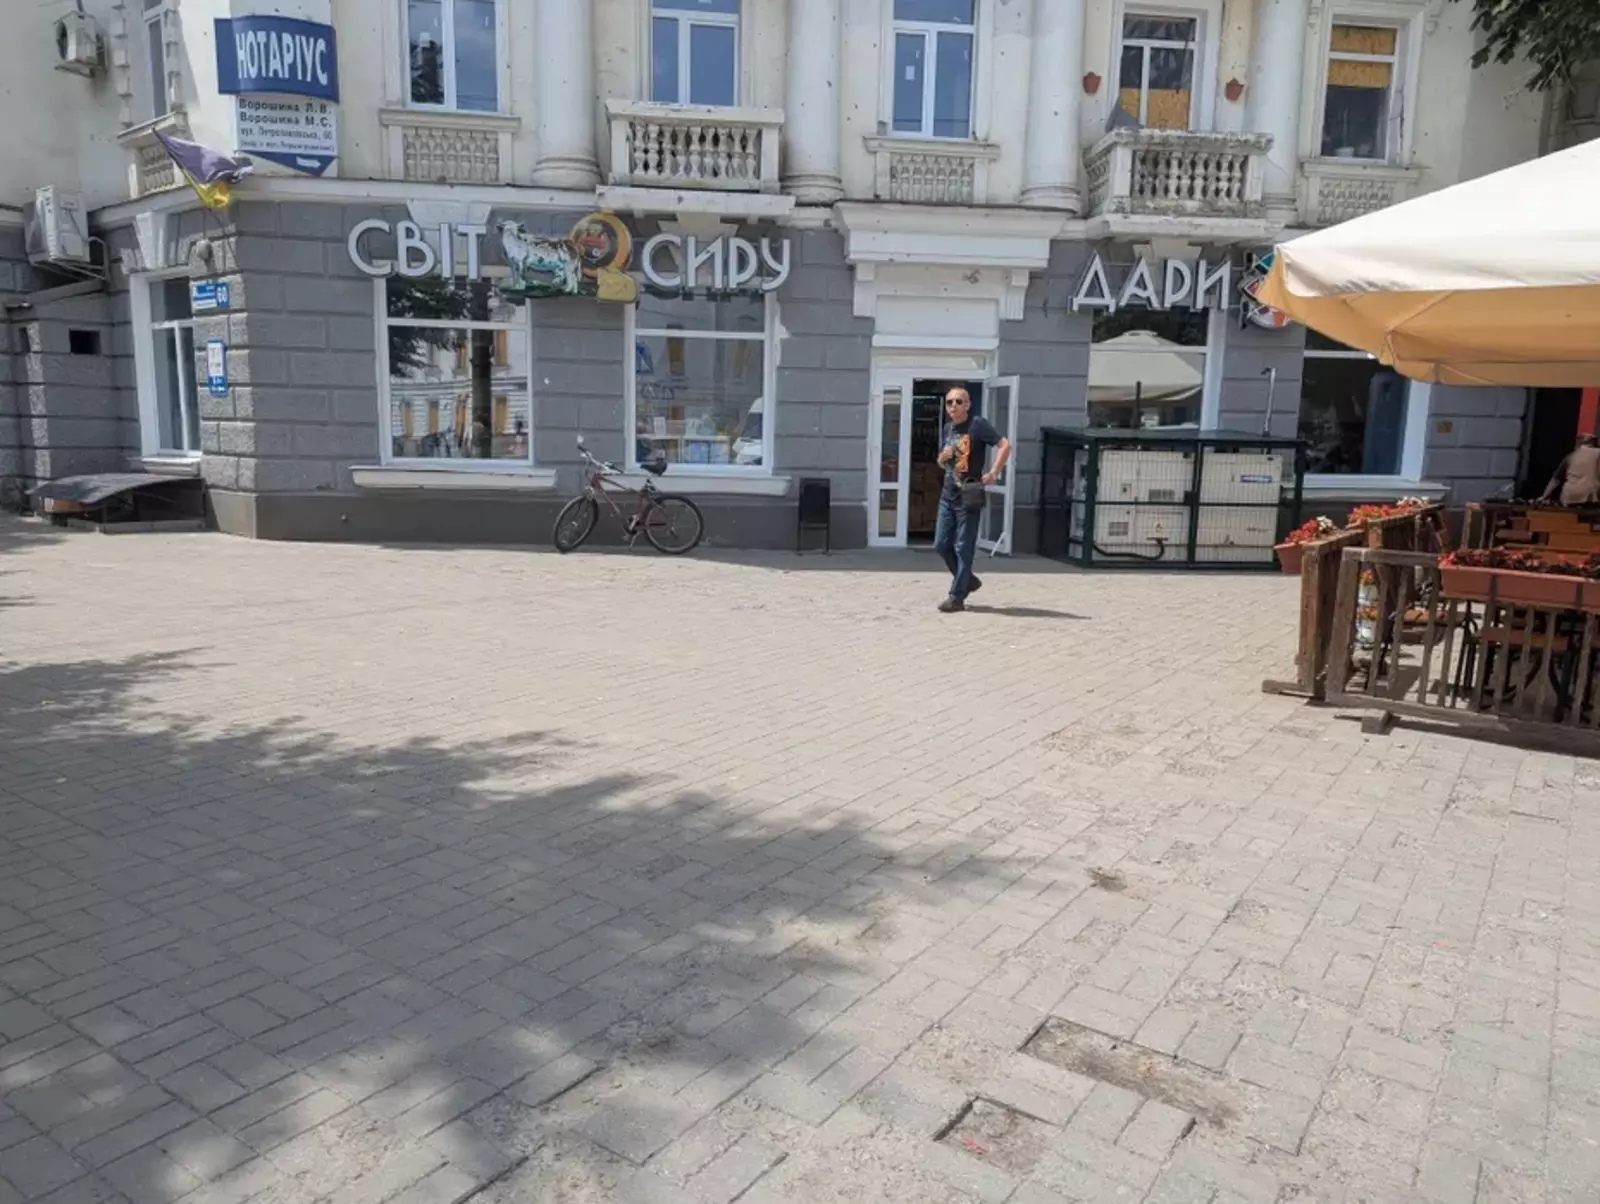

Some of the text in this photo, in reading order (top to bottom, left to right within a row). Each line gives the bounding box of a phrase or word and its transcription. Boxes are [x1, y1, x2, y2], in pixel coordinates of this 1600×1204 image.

[235, 30, 328, 86] НОТАРІУС
[348, 218, 791, 292] СВІТ СИРУ
[1072, 253, 1231, 312] ДАРИ
